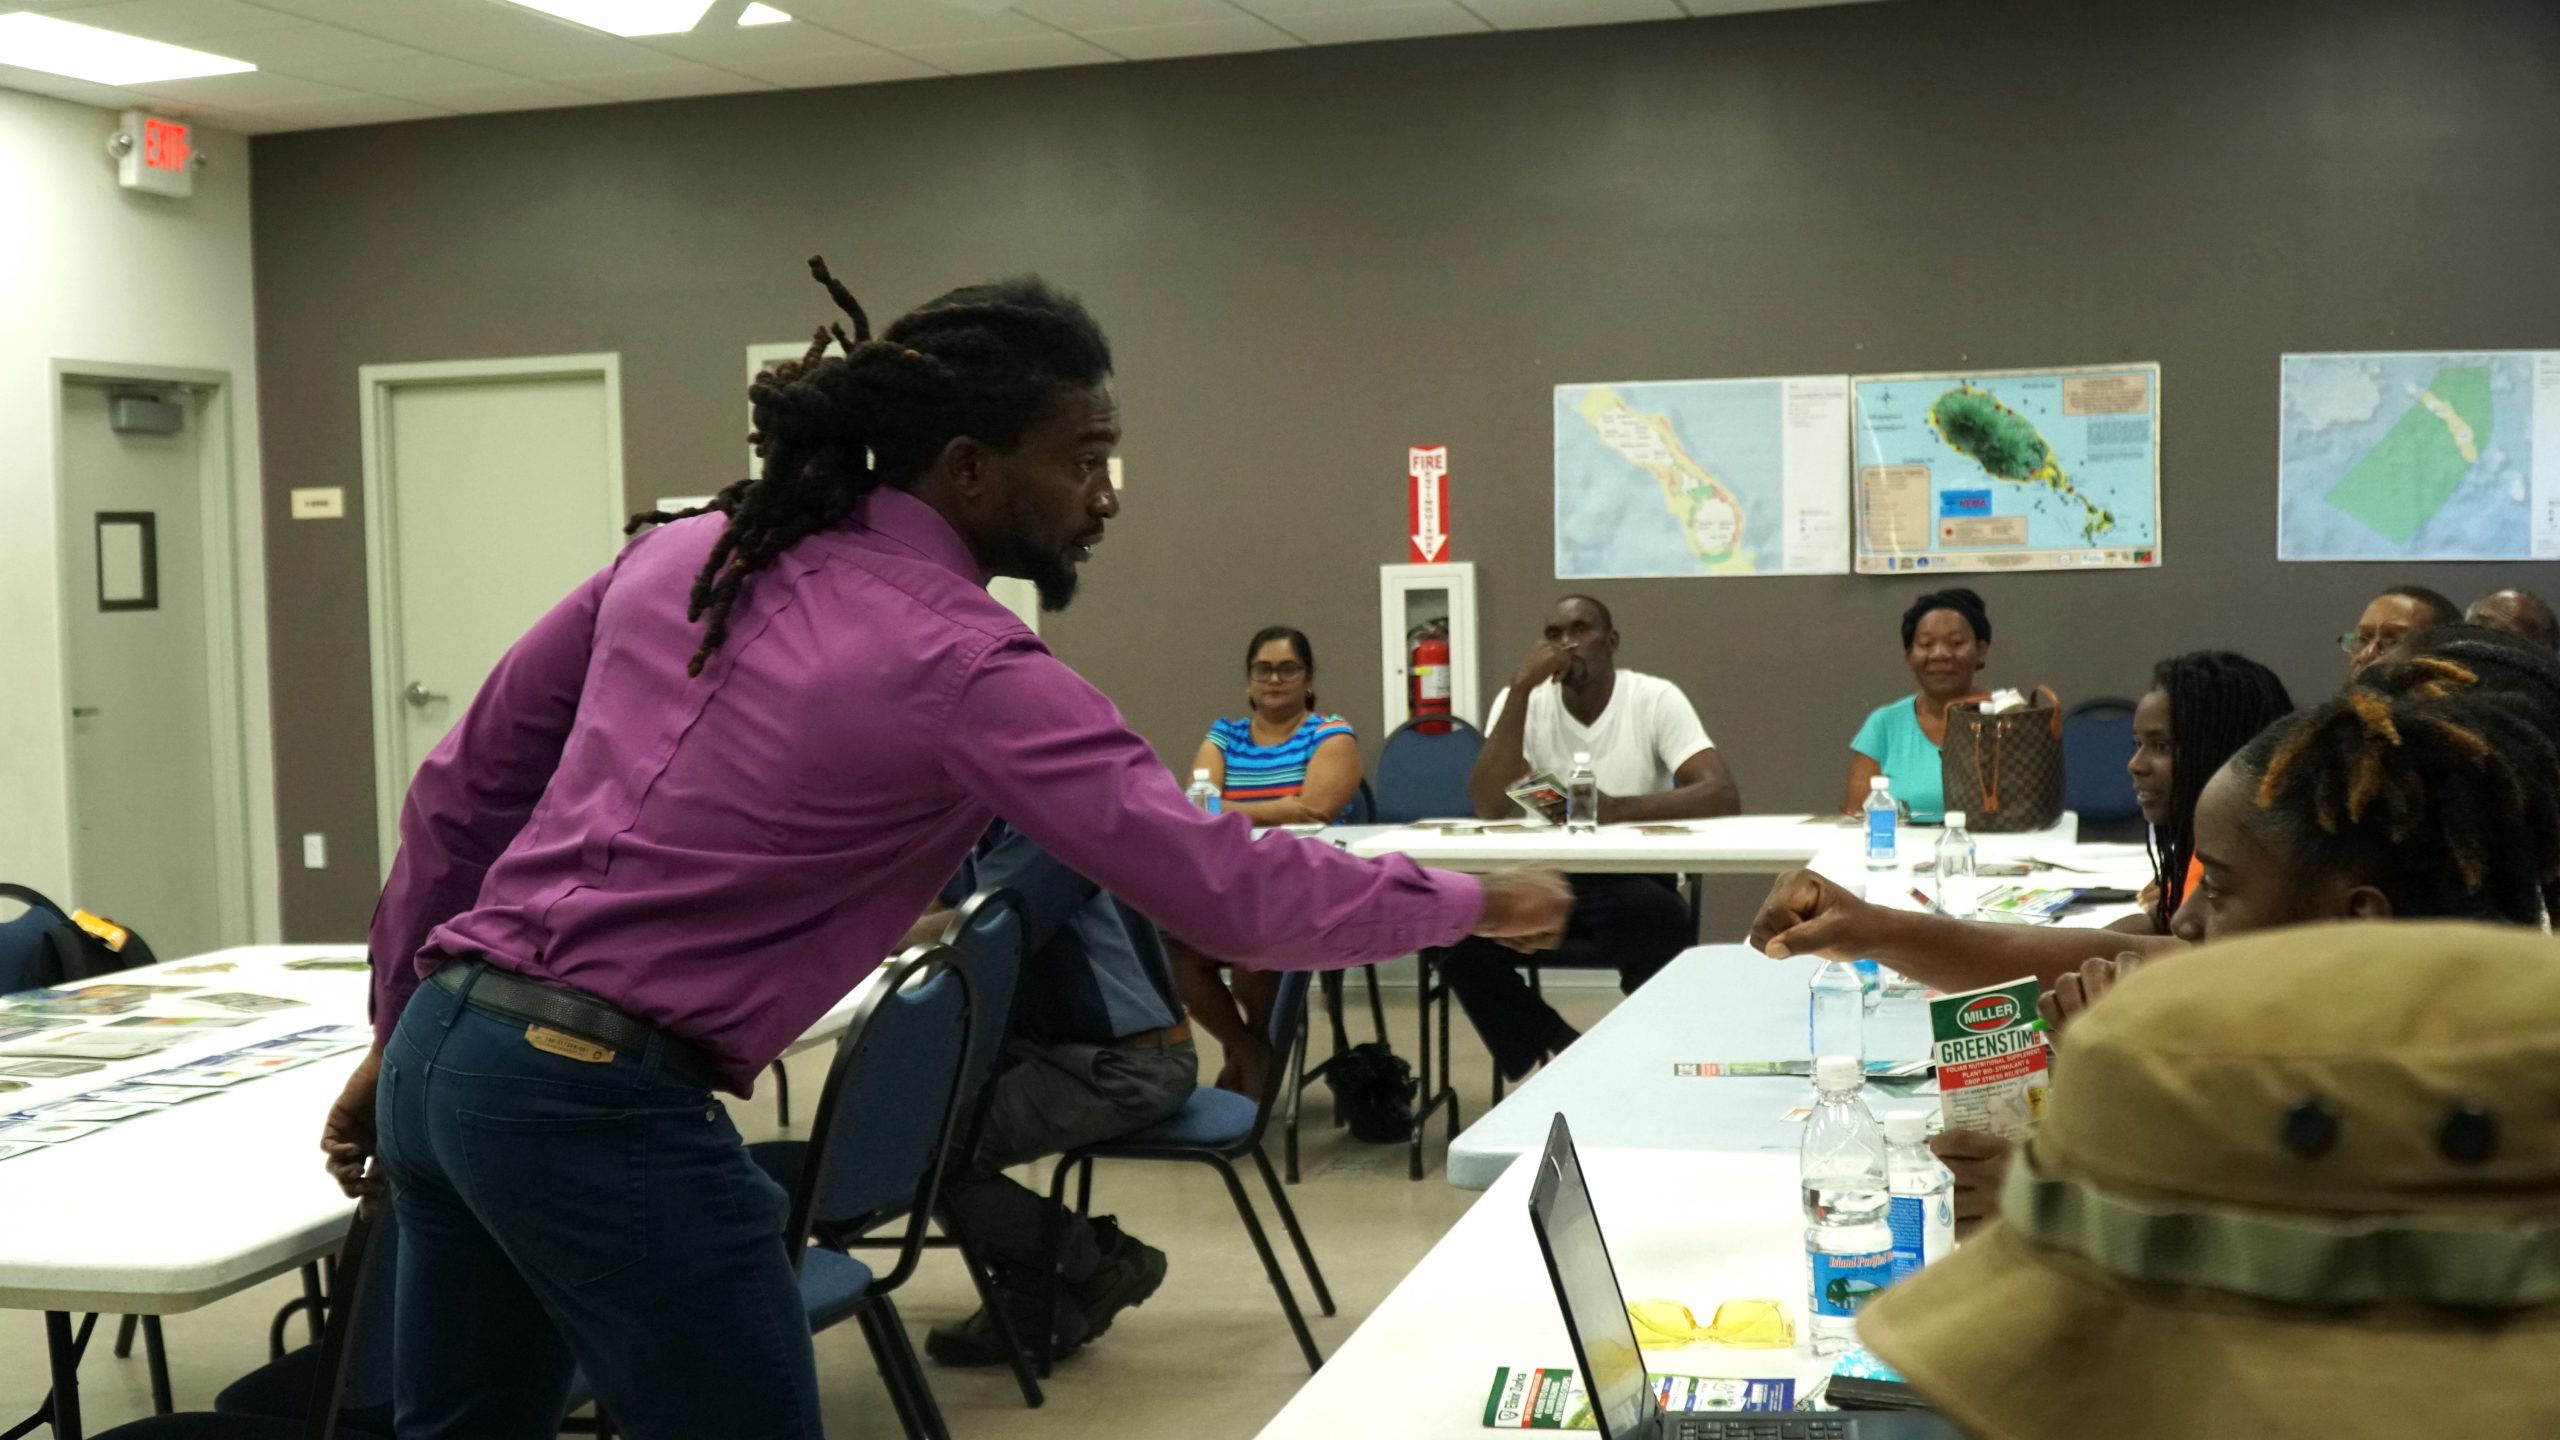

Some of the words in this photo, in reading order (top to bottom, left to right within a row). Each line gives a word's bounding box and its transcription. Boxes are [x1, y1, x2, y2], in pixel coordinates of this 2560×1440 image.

[145, 118, 187, 174] EXIT
[1412, 455, 1443, 470] FIRE
[1963, 1003, 2013, 1025] MILLER
[1941, 1029, 2035, 1064] GREENSTIM
[1946, 1064, 1968, 1073] FOLIAR
[1968, 1058, 2006, 1071] NUTRITIONAL
[1962, 1070, 1983, 1079] PLANT
[1964, 1078, 1981, 1086] CROP
[1981, 1073, 2004, 1084] STRESS
[2004, 1067, 2030, 1078] RELIEVER
[1829, 1255, 1857, 1268] Island
[1509, 1373, 1527, 1392] Zorka
[1504, 1391, 1521, 1409] Elixir
